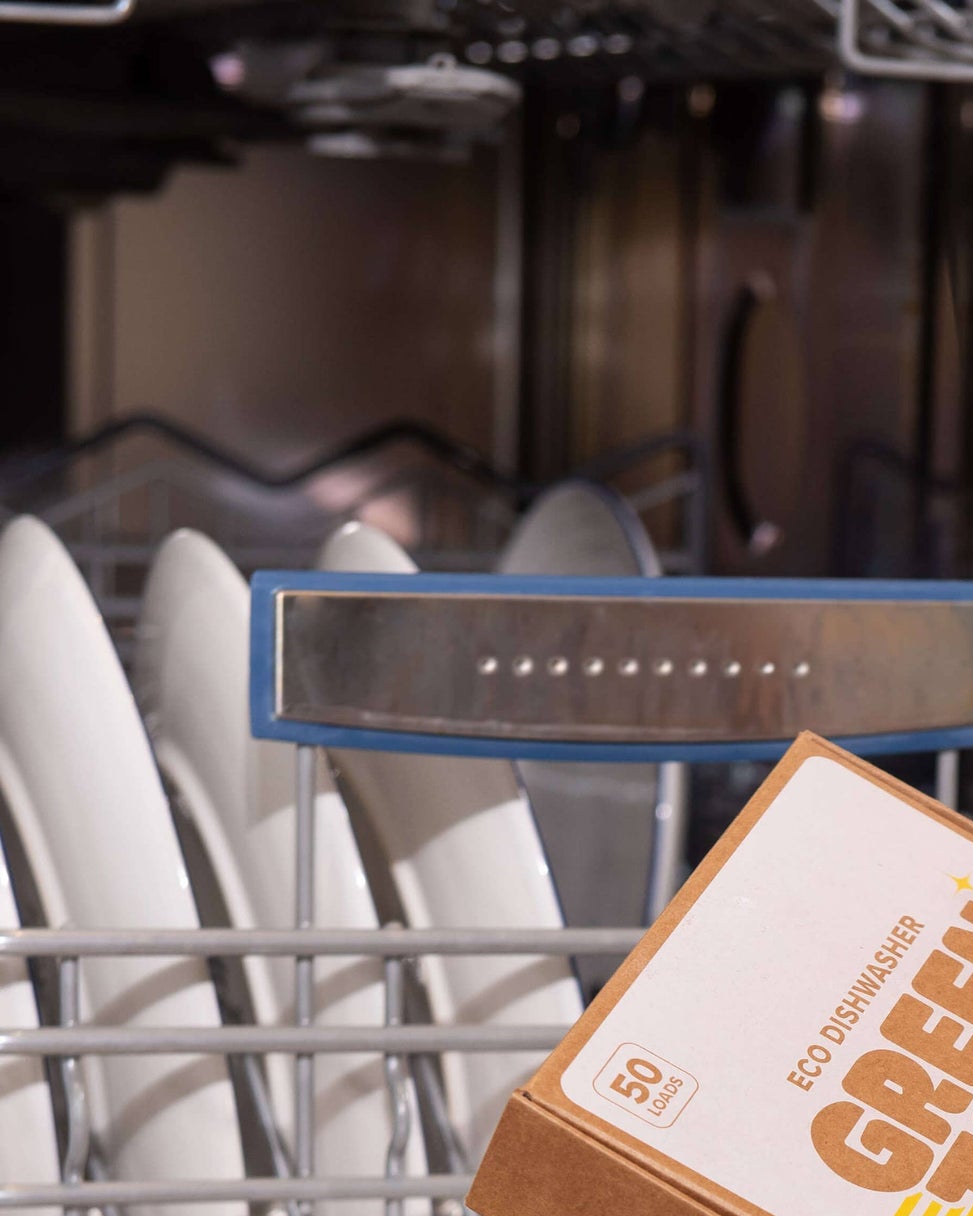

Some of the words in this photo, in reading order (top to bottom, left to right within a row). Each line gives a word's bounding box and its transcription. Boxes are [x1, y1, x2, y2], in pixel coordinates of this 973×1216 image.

[786, 1043, 832, 1092] ECO
[819, 914, 925, 1045] DISHWASHER
[609, 1058, 663, 1104] 50
[647, 1076, 683, 1117] LOADS
